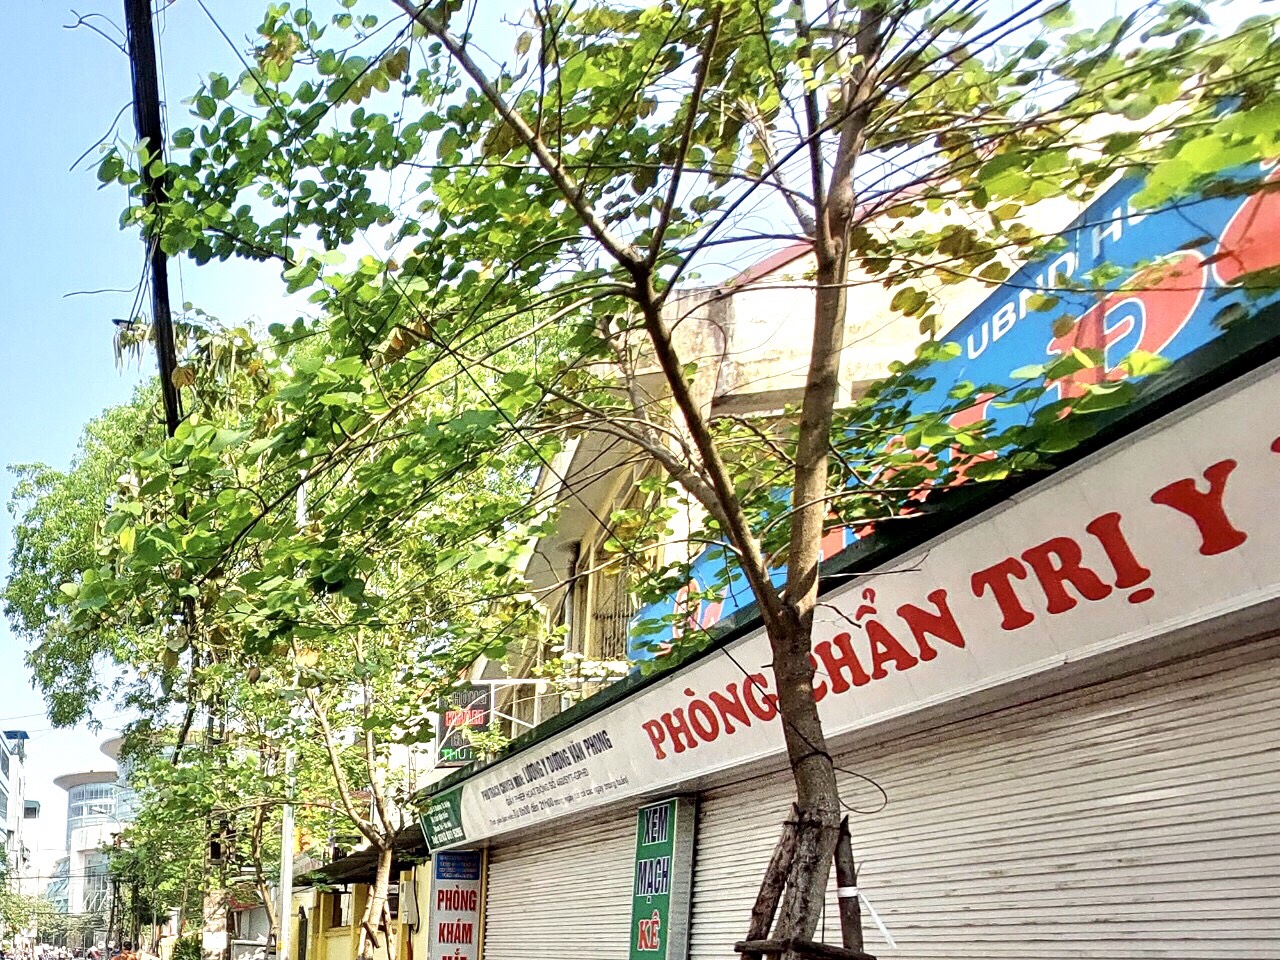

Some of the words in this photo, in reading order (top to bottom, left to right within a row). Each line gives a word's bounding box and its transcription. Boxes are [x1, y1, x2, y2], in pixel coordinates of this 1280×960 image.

[966, 251, 1076, 359] UBND
[642, 687, 780, 761] PHÒNG
[971, 511, 1156, 633] TRỊ
[1151, 457, 1248, 557] Y
[583, 729, 613, 758] PHONG
[642, 803, 671, 847] XEM
[436, 884, 478, 913] PHÒNG
[635, 855, 671, 904] MẠCH
[438, 918, 474, 945] KHÁM
[637, 909, 661, 952] KÊ
